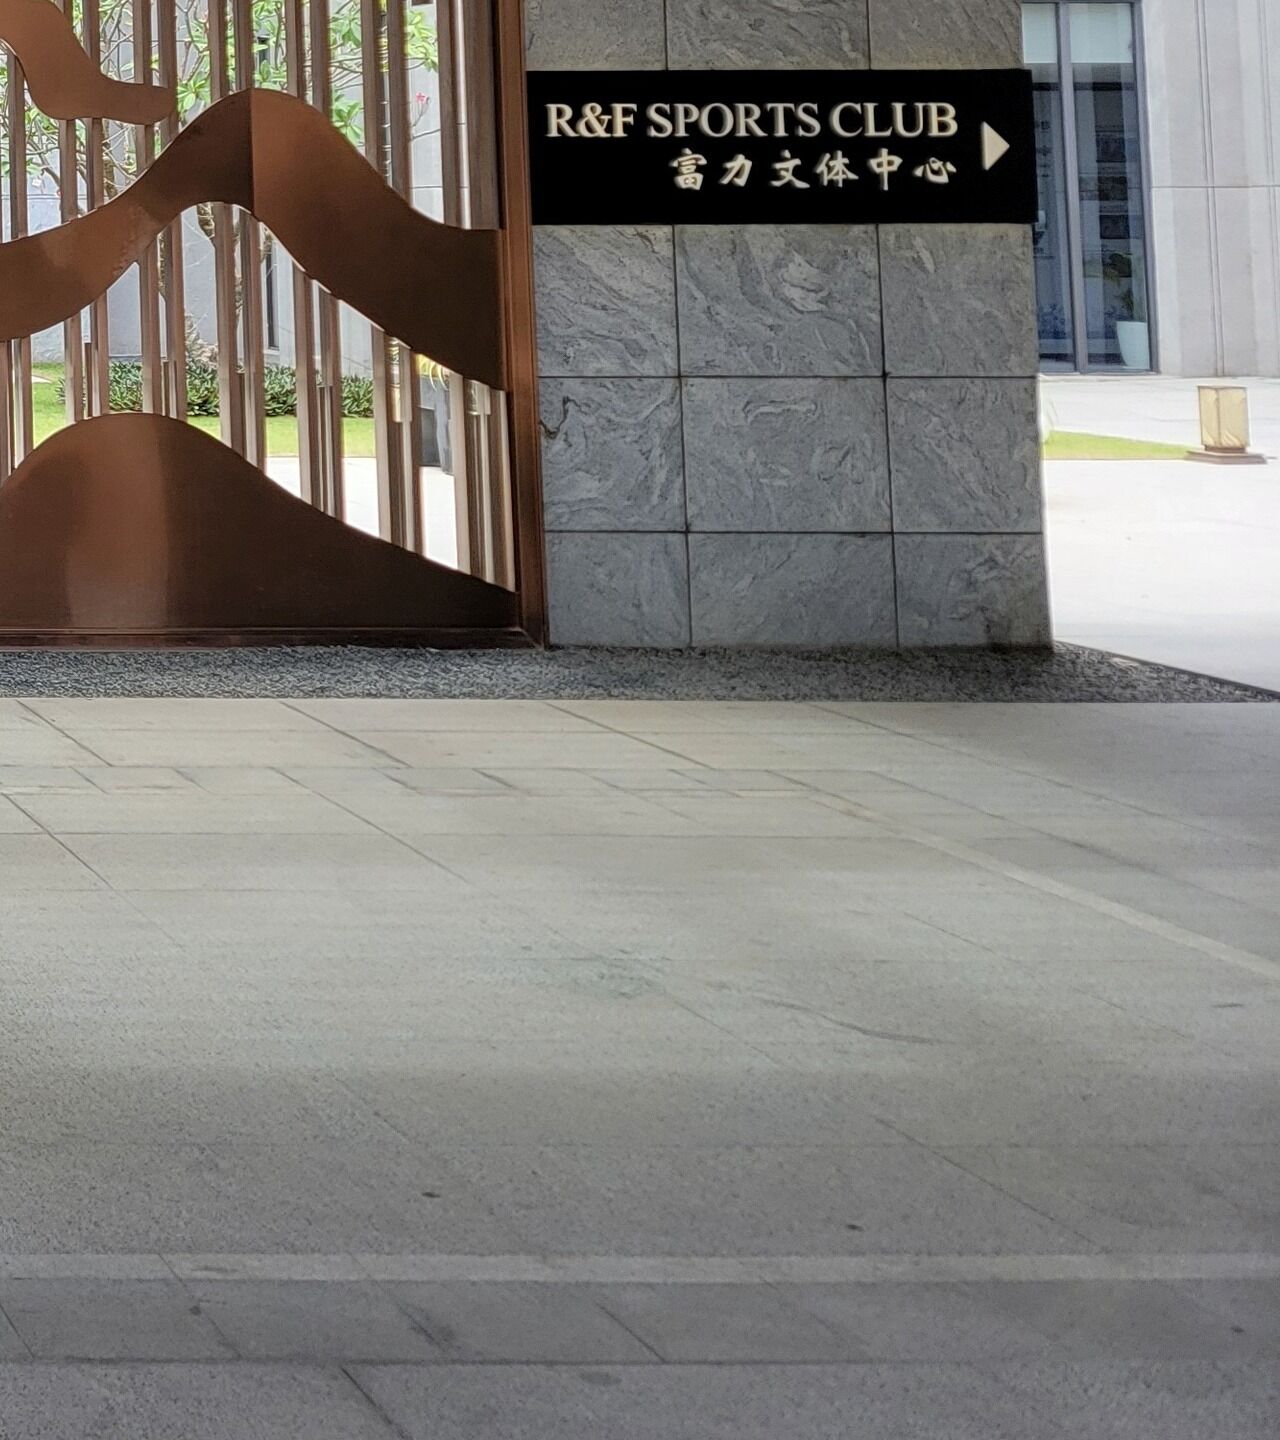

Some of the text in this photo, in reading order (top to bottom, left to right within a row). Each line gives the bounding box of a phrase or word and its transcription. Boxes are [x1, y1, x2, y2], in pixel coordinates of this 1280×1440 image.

[546, 103, 958, 138] R&F SPORTS CLUB
[669, 148, 957, 191] 富力文体中心
